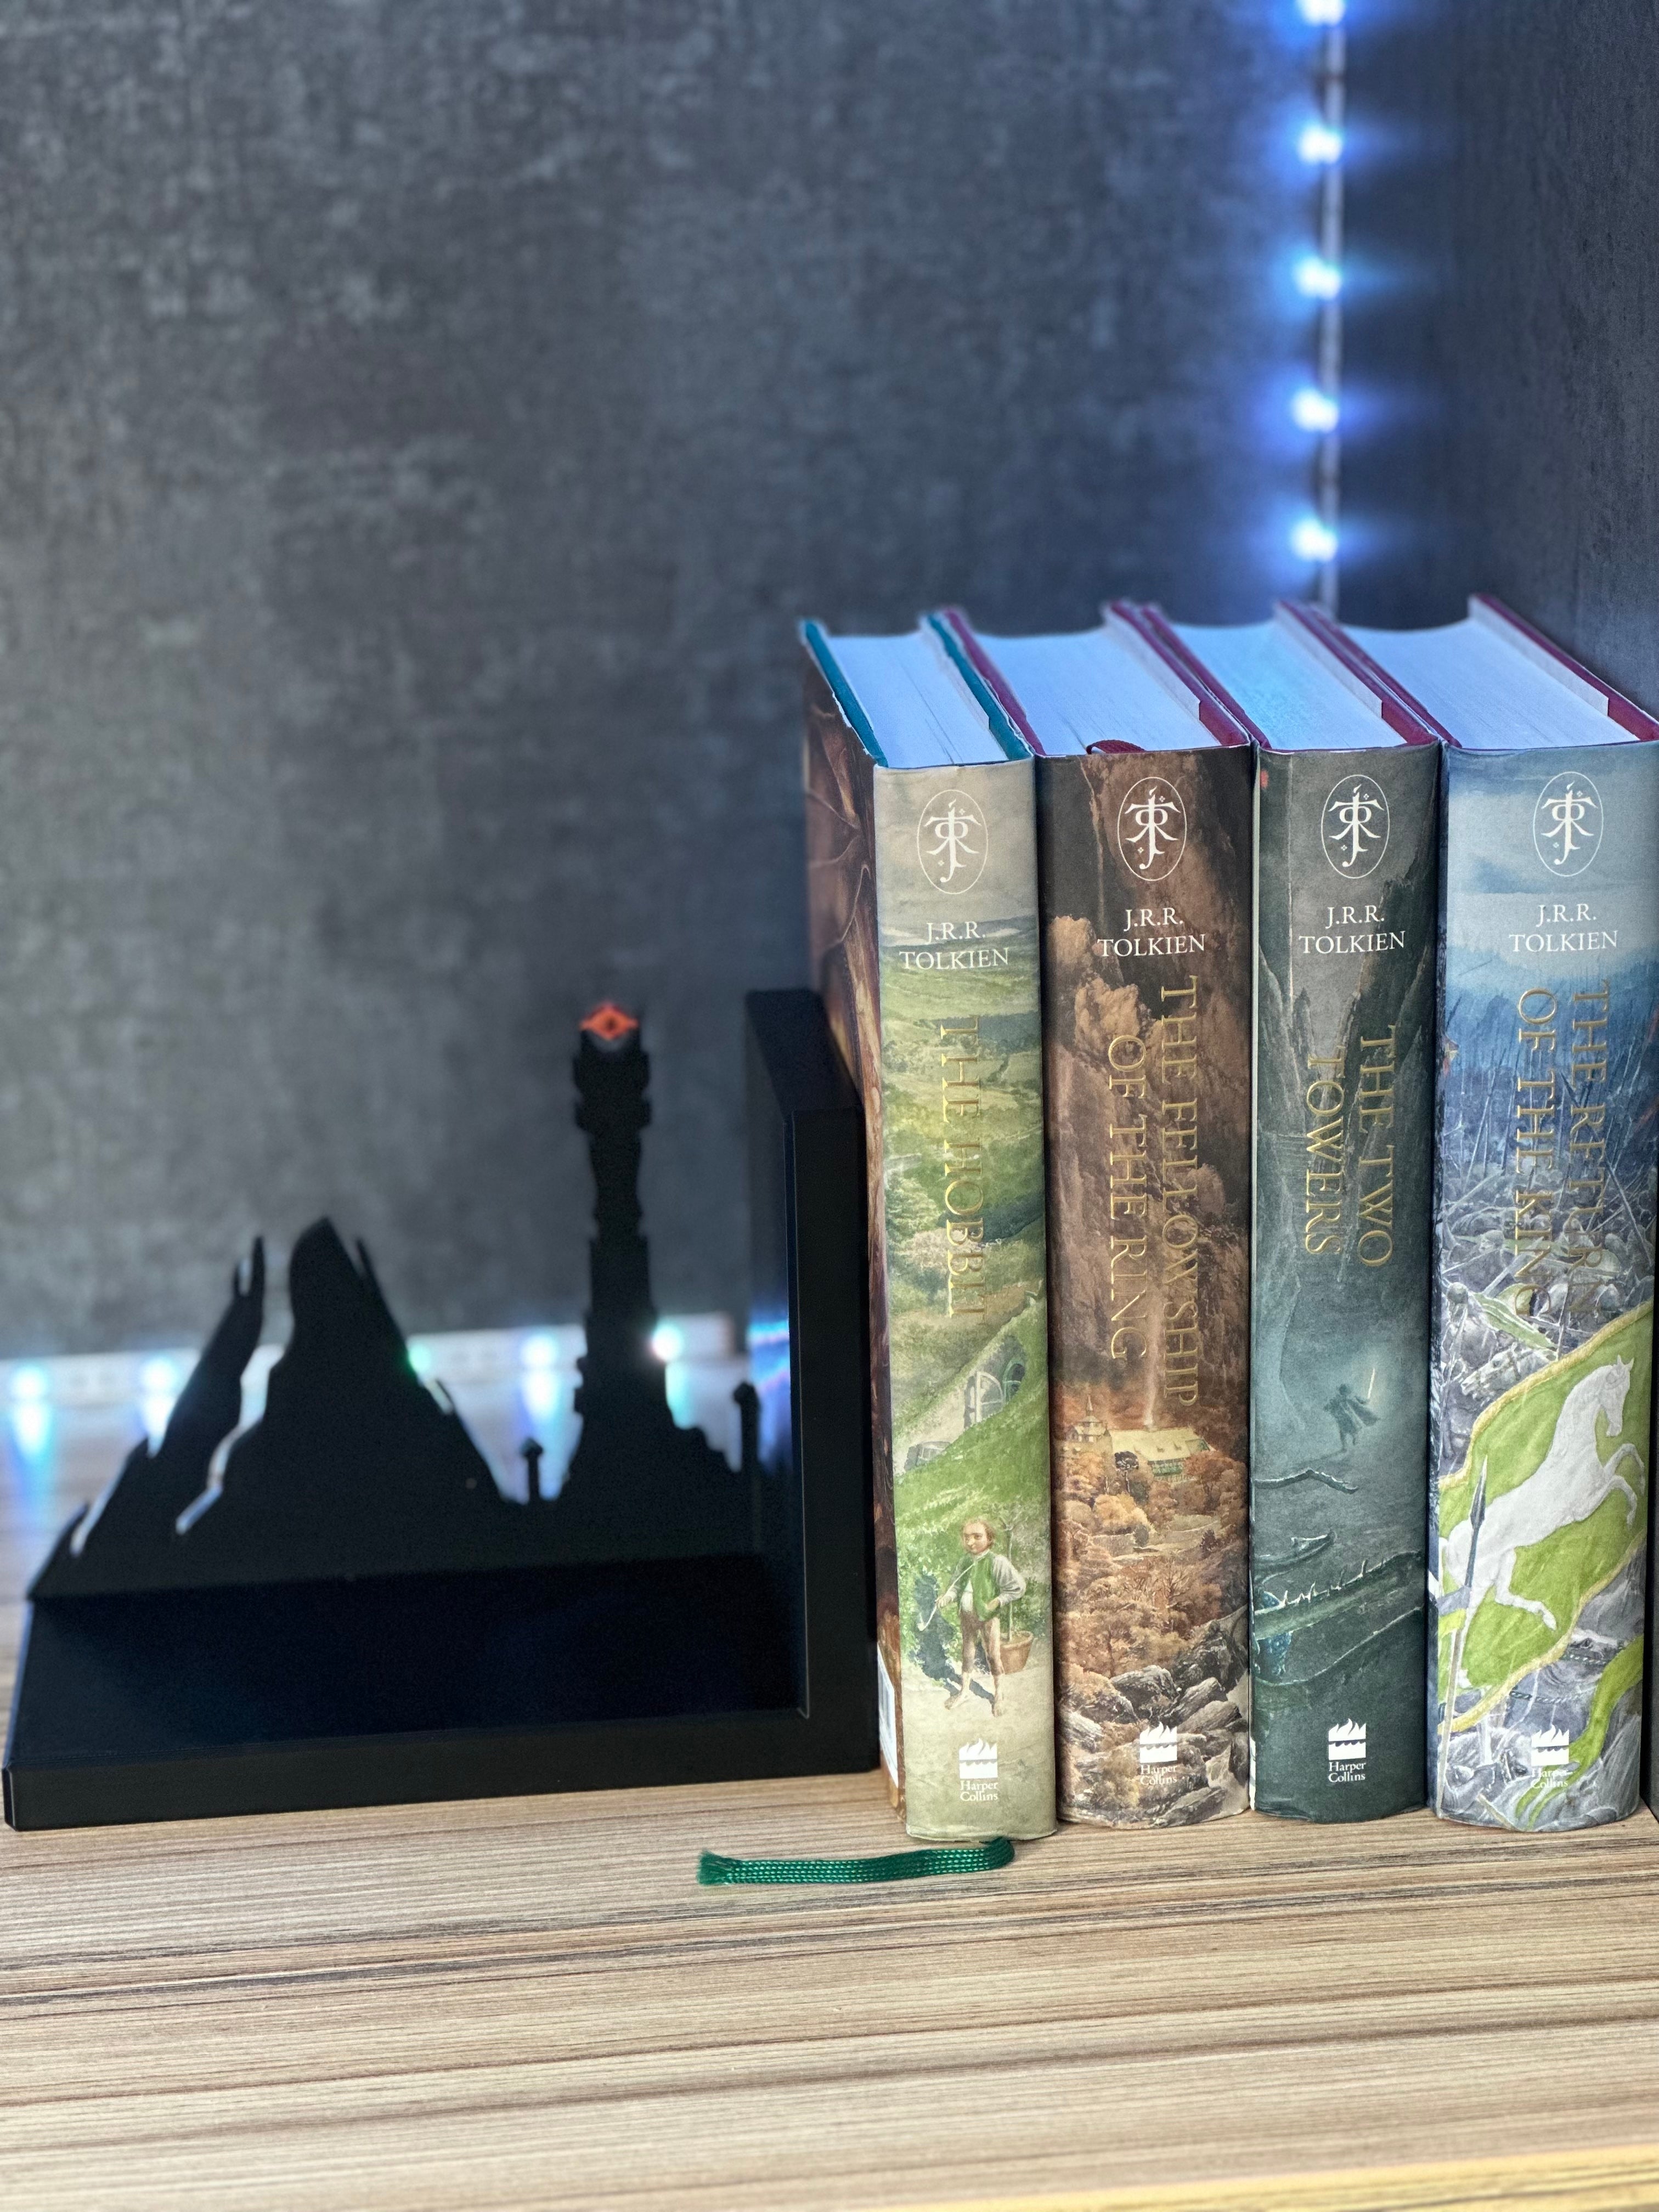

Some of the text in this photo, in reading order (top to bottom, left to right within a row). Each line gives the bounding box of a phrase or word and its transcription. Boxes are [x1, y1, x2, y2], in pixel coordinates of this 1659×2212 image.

[1124, 907, 1183, 932] J.R.R.
[1325, 905, 1385, 929] J.R.R.
[1536, 903, 1597, 927] J.R.R.
[926, 921, 986, 943] J.R.R.
[1299, 930, 1406, 955] TOLKIEN
[1509, 930, 1619, 953] TOLKIEN
[1097, 934, 1206, 957] TOLKIEN
[899, 949, 1009, 970] TOLKIEN
[1305, 1045, 1345, 1256] TOWERS
[1358, 1024, 1396, 1267] THE TWO
[1514, 987, 1558, 1318] OF THE KING
[1567, 978, 1611, 1318] THE RETURN
[940, 1014, 986, 1324] THE HOBBIT
[1108, 1035, 1148, 1362] OF THE RING
[1161, 975, 1200, 1407] THE FELLOWSHIP
[1139, 1763, 1177, 1776] Harper
[1328, 1761, 1366, 1773] Harper
[1328, 1772, 1365, 1783] Collins
[960, 1780, 998, 1793] Harper
[1139, 1774, 1177, 1786] Collins
[960, 1791, 998, 1802] Collins
